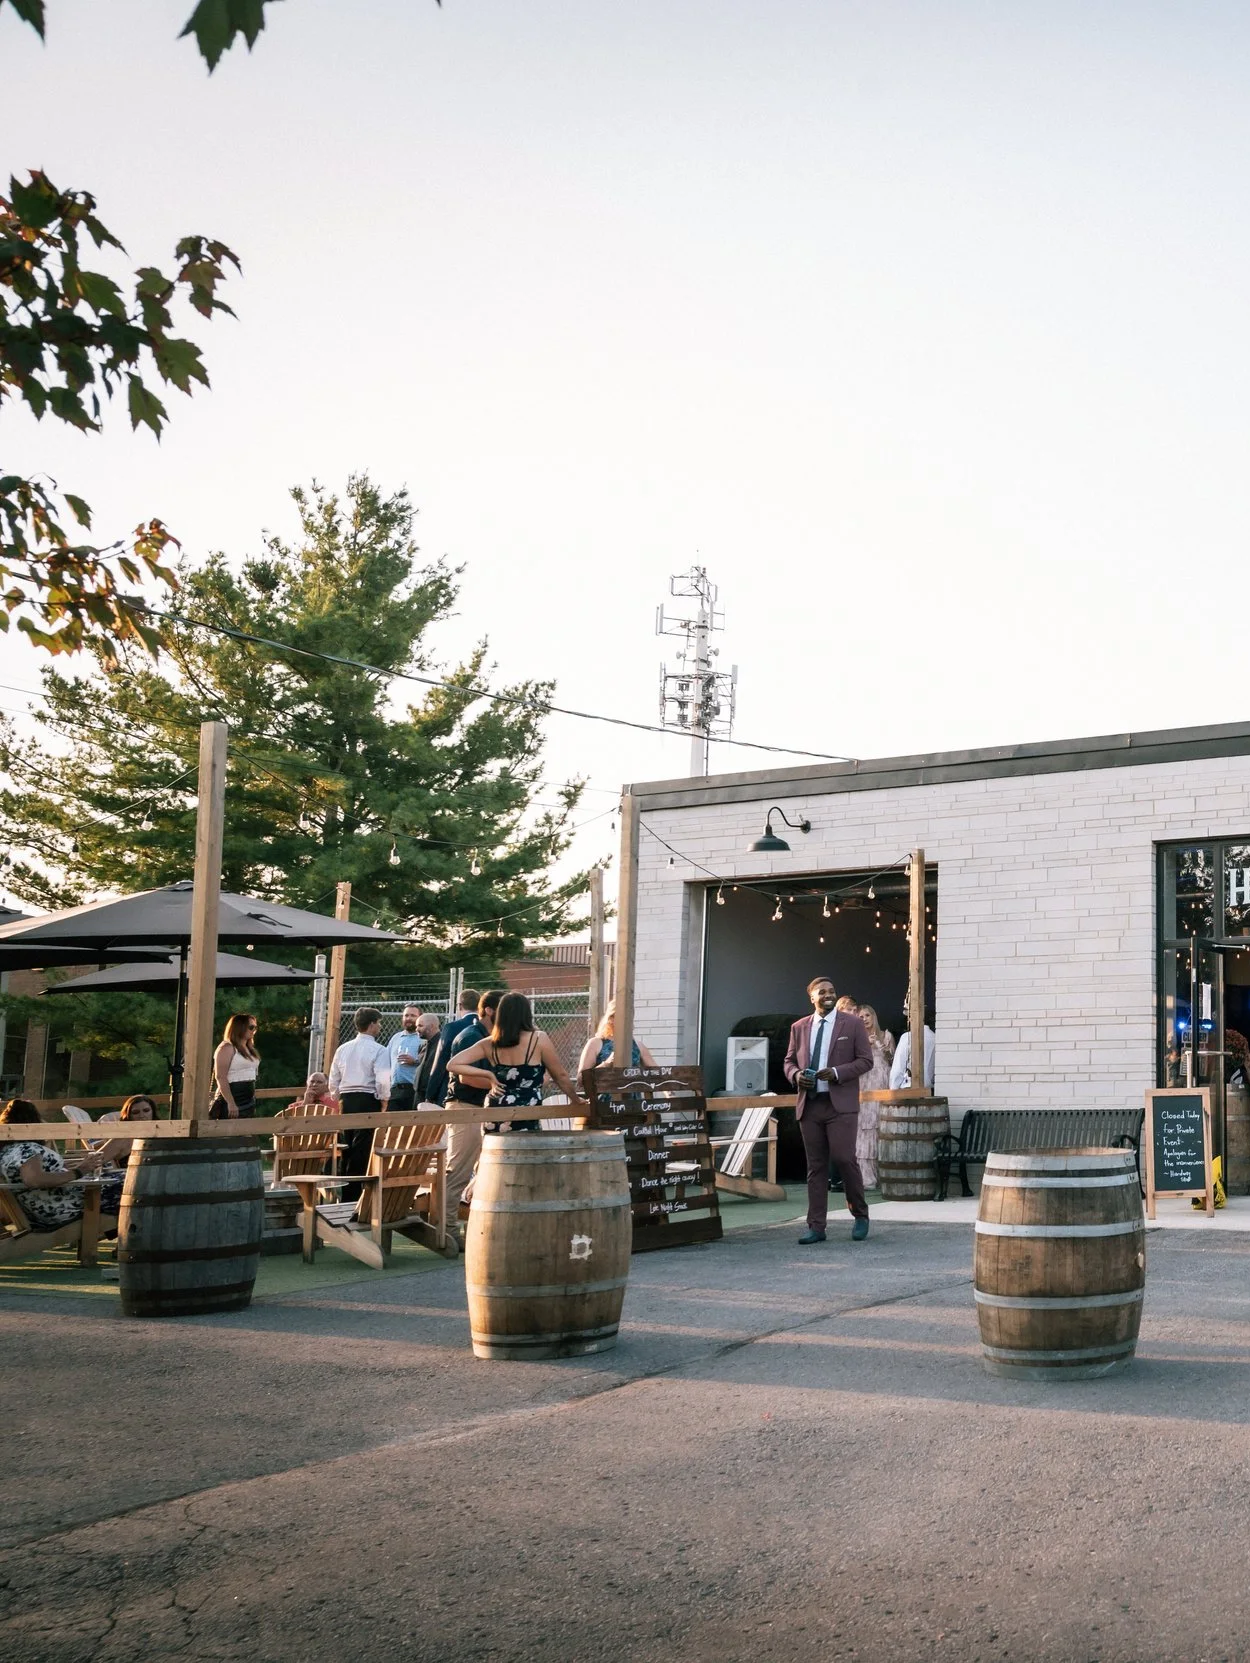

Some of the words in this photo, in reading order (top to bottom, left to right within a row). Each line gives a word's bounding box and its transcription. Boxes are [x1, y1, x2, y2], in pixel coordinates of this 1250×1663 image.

[623, 1068, 641, 1077] ORDER
[661, 1067, 673, 1075] DAY
[609, 1102, 626, 1114] 4pm
[641, 1100, 671, 1112] Ceremony
[1161, 1110, 1185, 1120] Closed
[1186, 1110, 1201, 1121] Today
[654, 1125, 667, 1135] Hour
[1163, 1123, 1175, 1134] for
[1176, 1123, 1195, 1134] Private
[648, 1149, 670, 1161] Dinner
[1164, 1159, 1174, 1167] the
[641, 1177, 659, 1188] Dance
[660, 1177, 669, 1186] the
[669, 1174, 681, 1185] night
[650, 1203, 660, 1214] Late
[660, 1202, 673, 1213] Night
